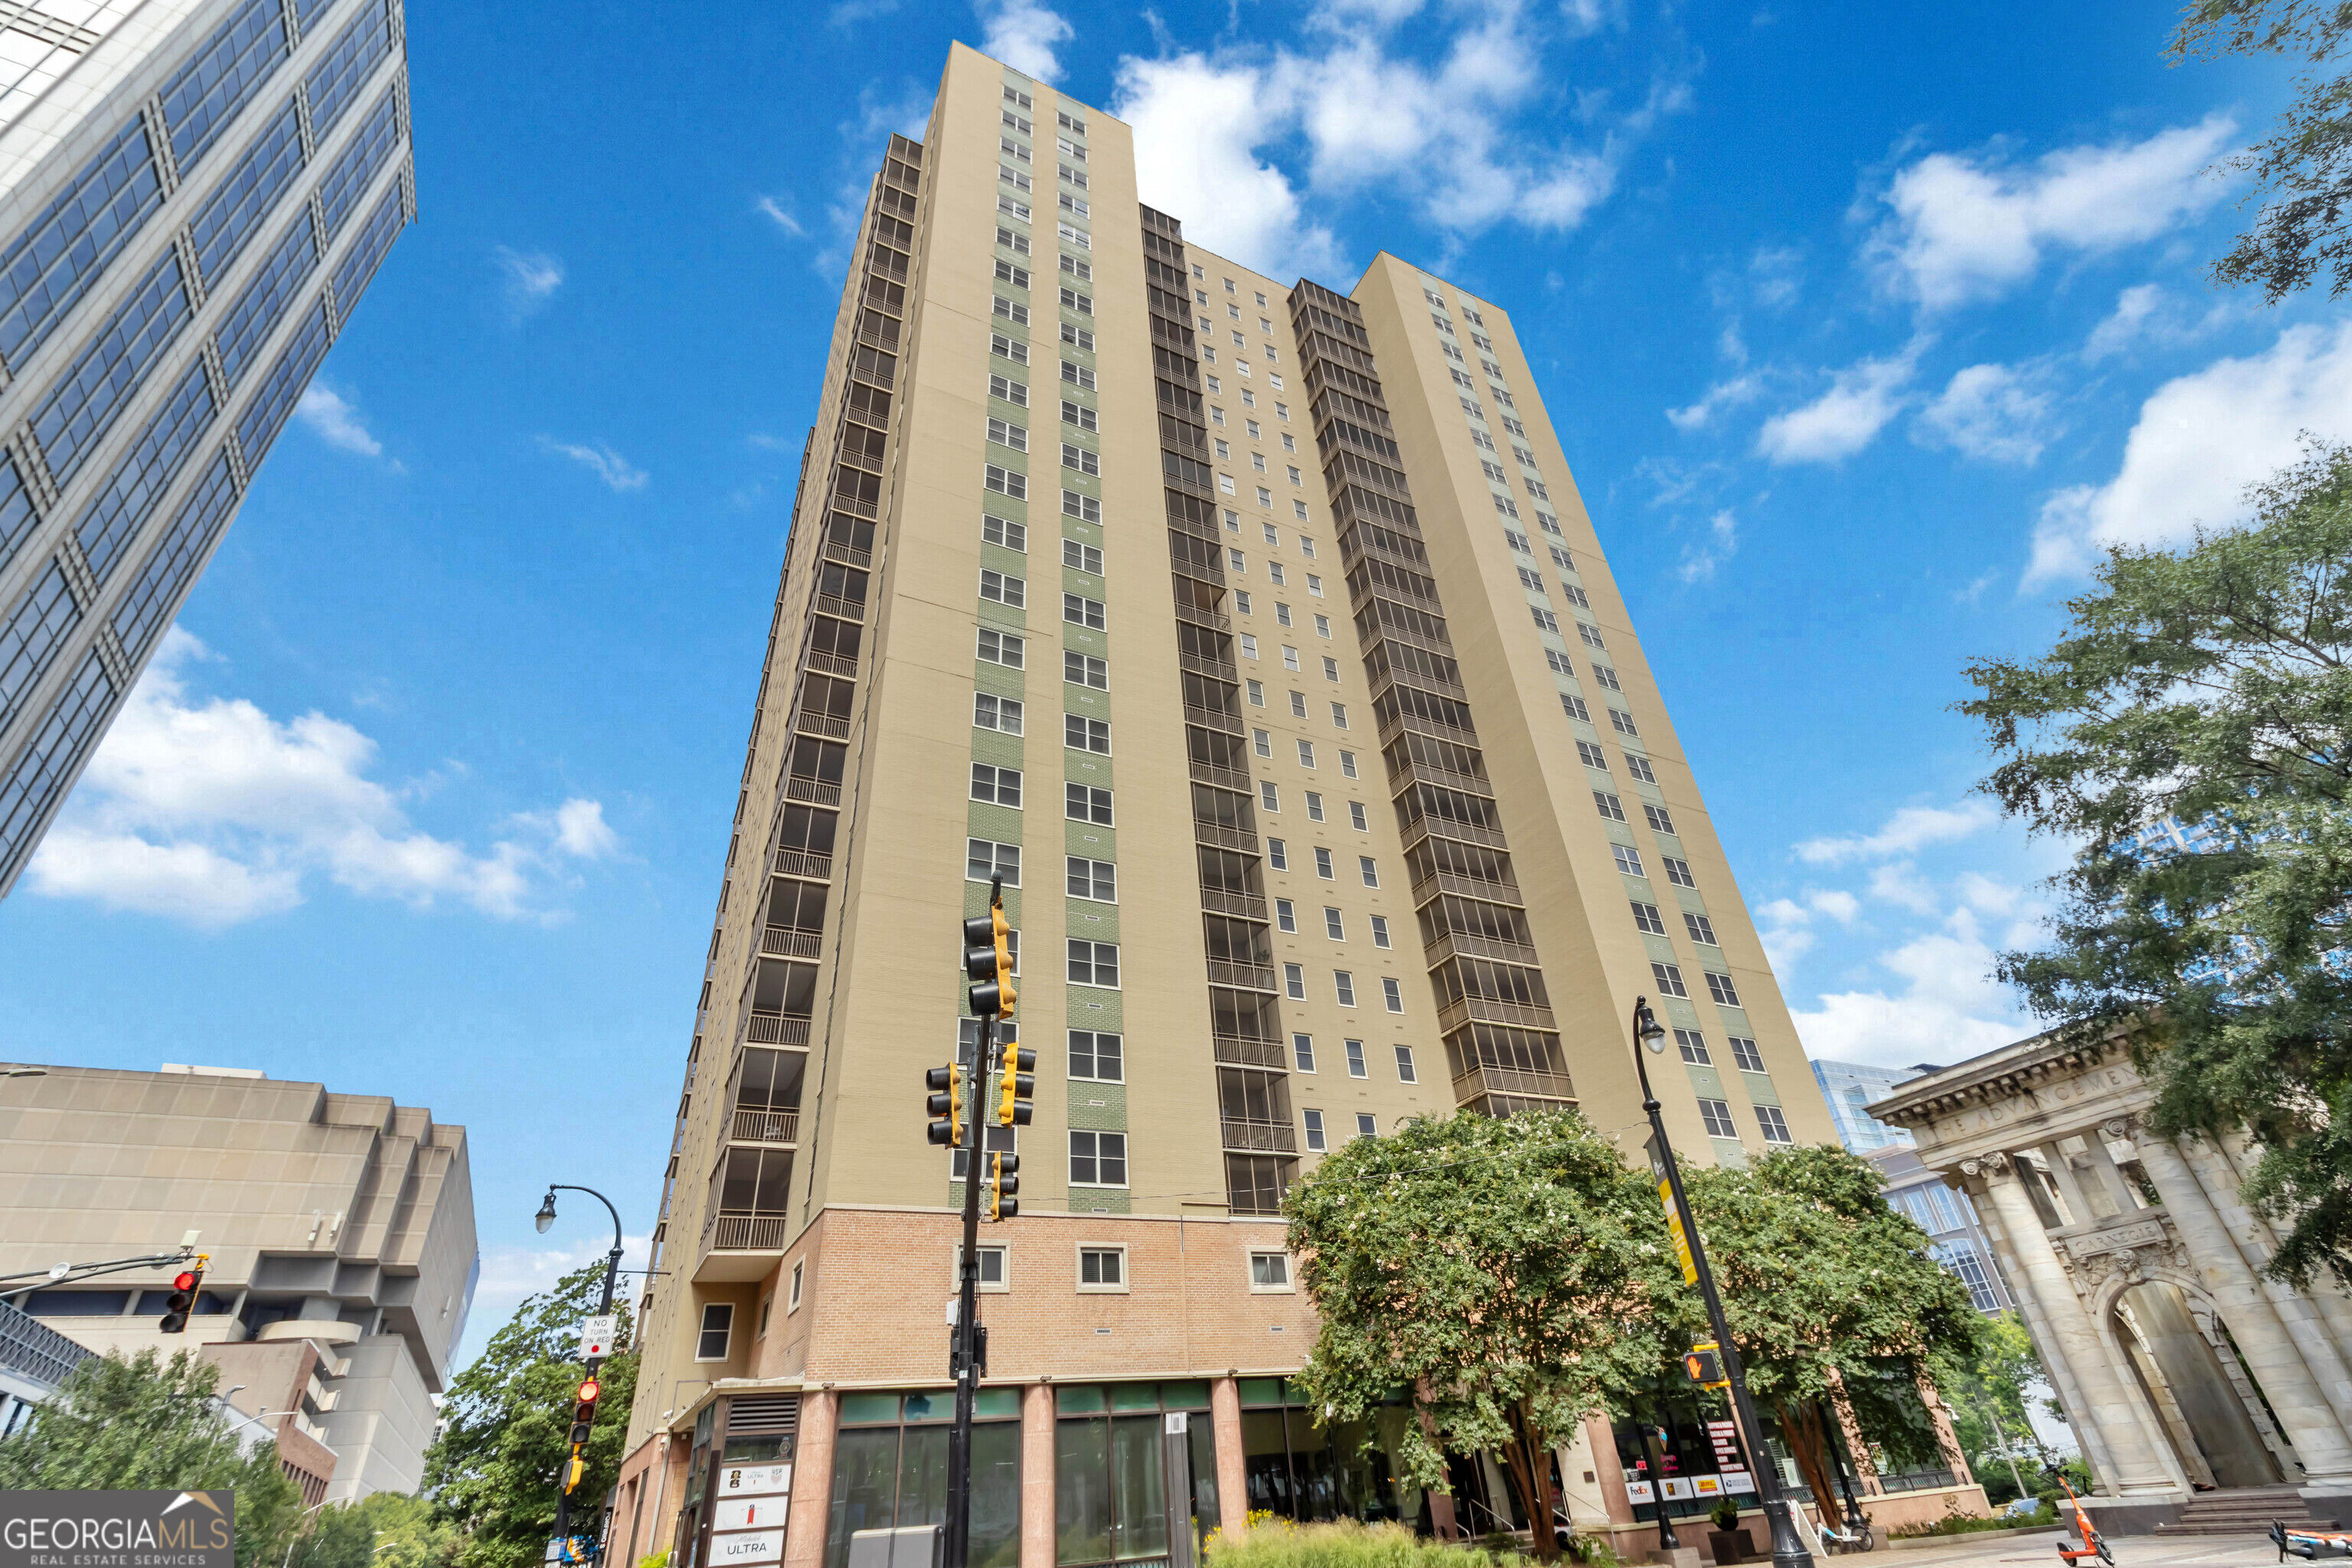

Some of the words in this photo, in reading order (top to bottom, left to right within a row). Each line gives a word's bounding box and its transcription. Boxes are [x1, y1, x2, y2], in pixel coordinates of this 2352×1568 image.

[1978, 1067, 2140, 1127] ADVANCEMEN
[2076, 1226, 2156, 1252] CARNEGIE
[1630, 1485, 1648, 1496] FedEx
[727, 1543, 766, 1555] ULTRA
